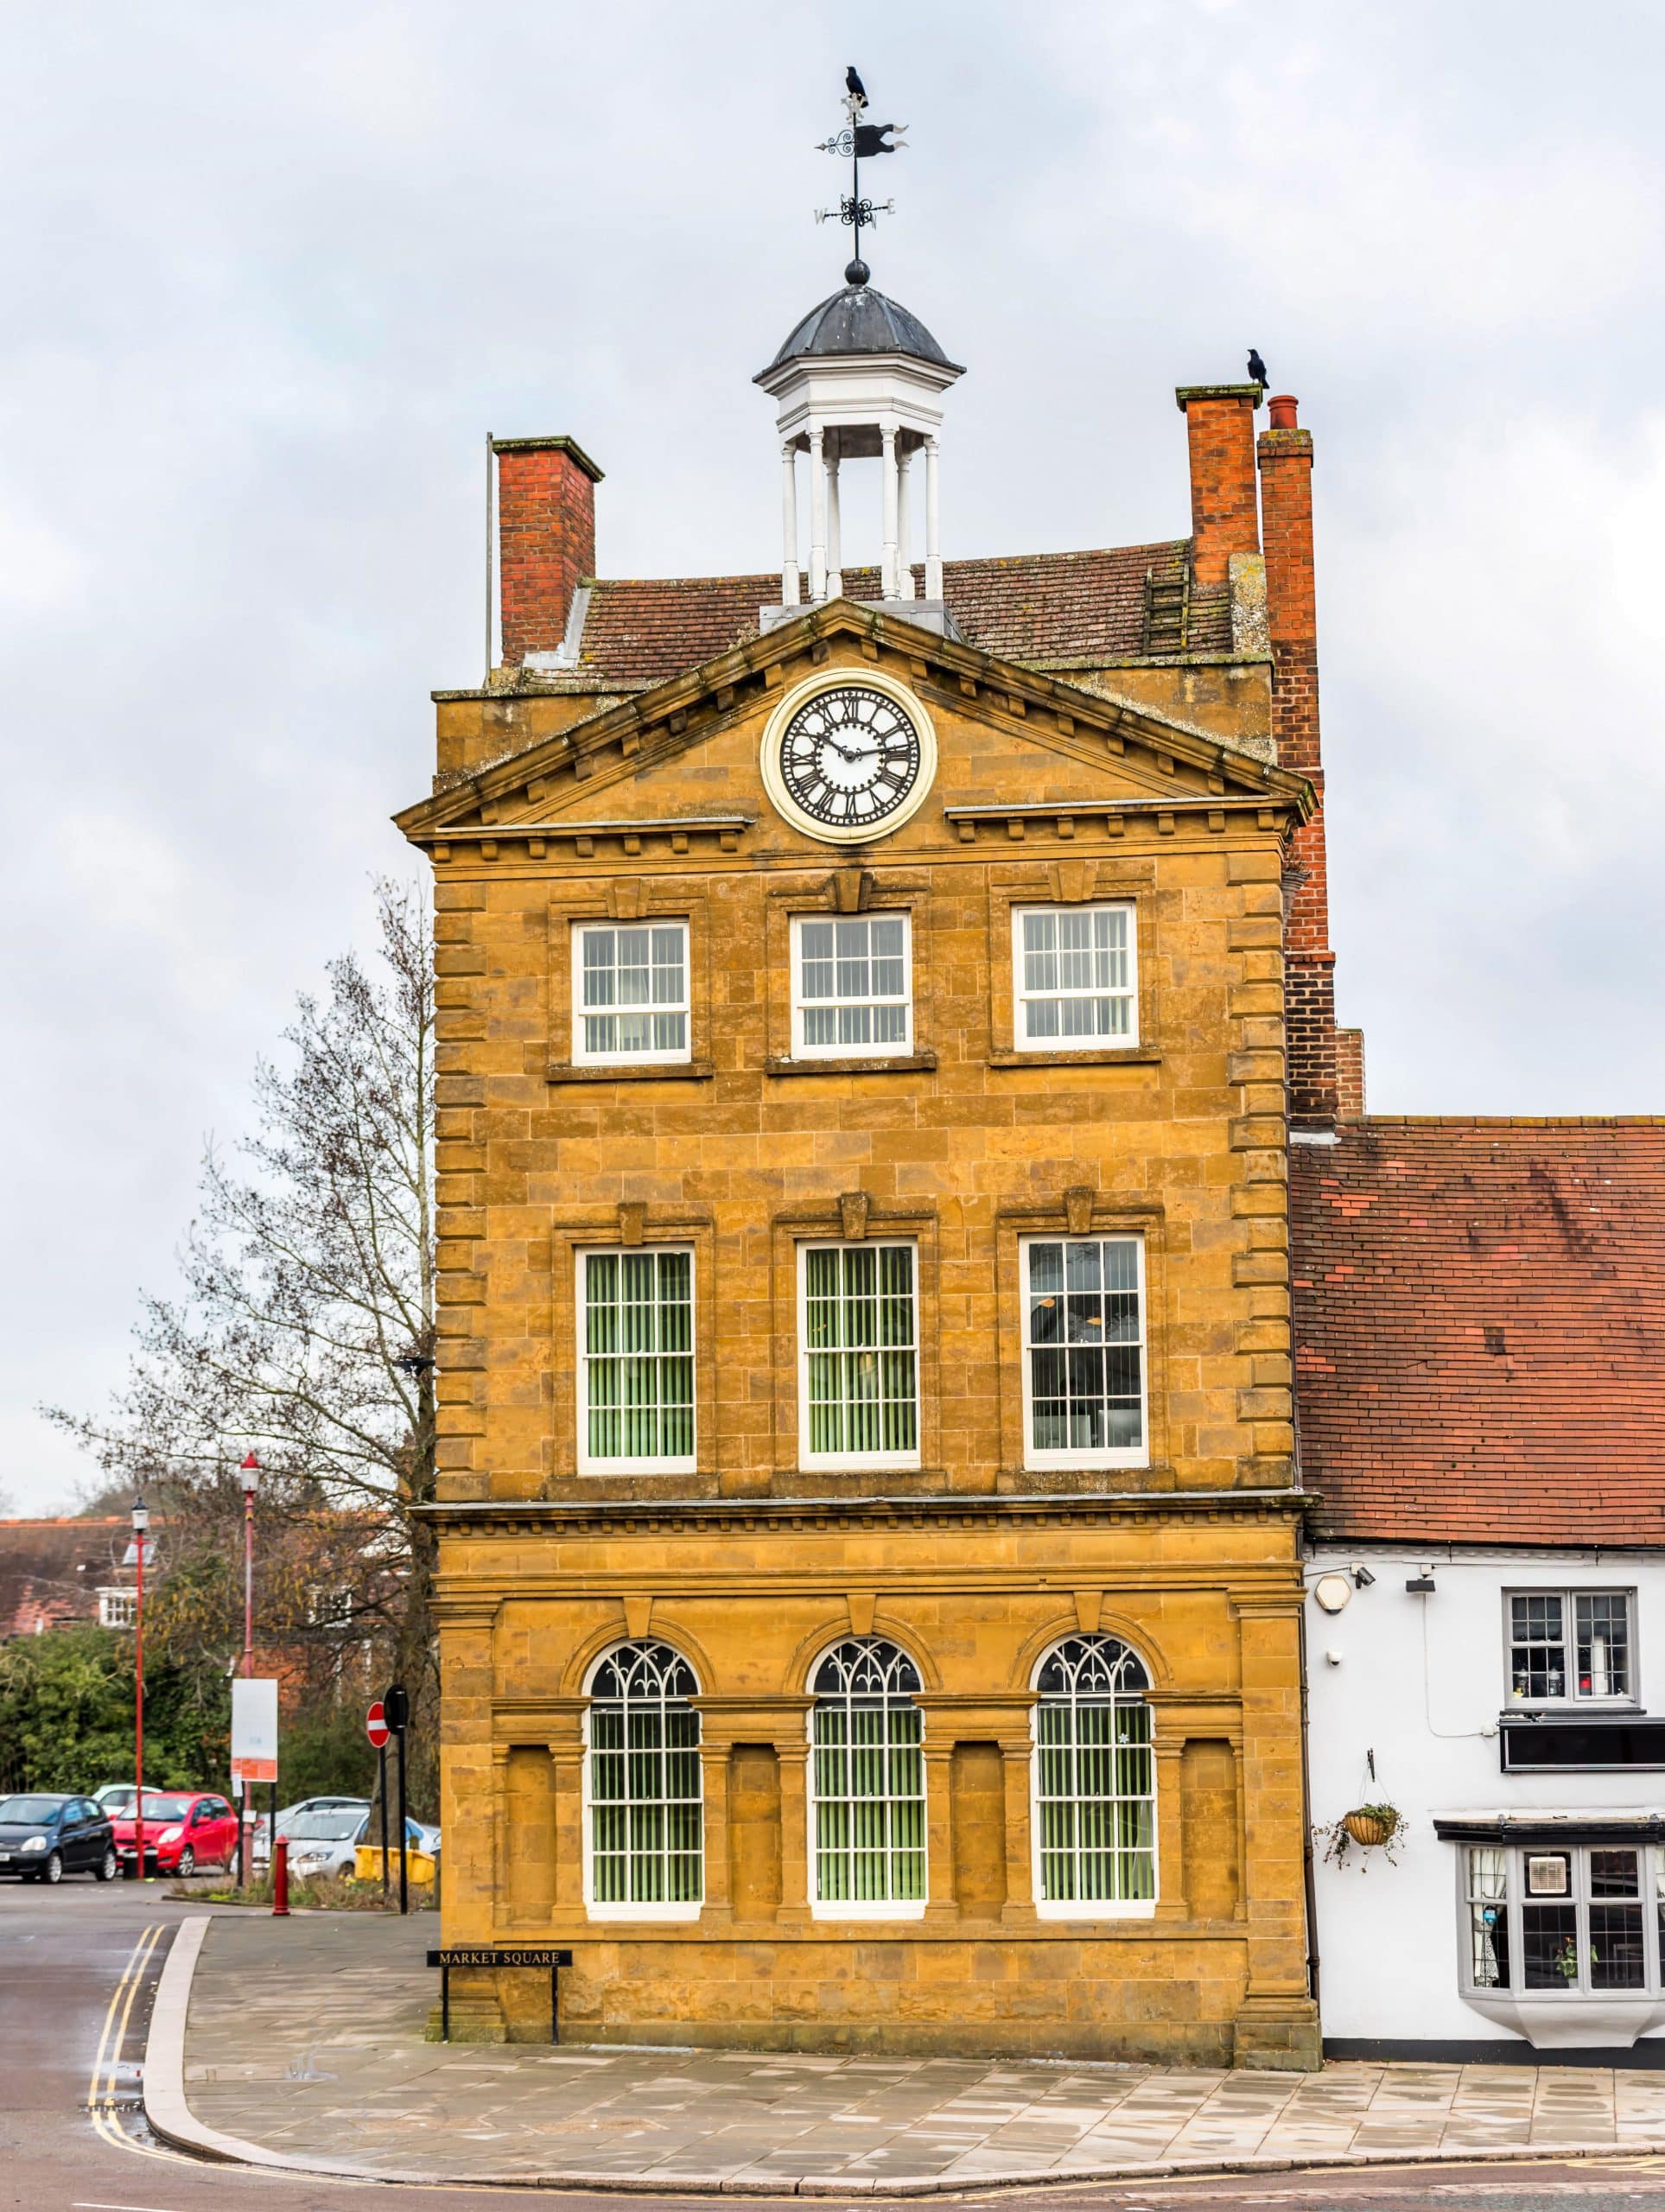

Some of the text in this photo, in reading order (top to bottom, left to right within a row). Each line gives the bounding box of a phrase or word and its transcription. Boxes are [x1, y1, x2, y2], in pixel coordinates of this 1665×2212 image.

[813, 207, 828, 226] W
[815, 702, 837, 732] XI
[842, 697, 860, 722] XII
[880, 721, 906, 740] II
[790, 751, 817, 766] IX
[795, 770, 823, 798] VIII
[814, 788, 838, 815] VII
[842, 792, 858, 817] VI
[439, 1952, 560, 1966] MARKET SQUARE
